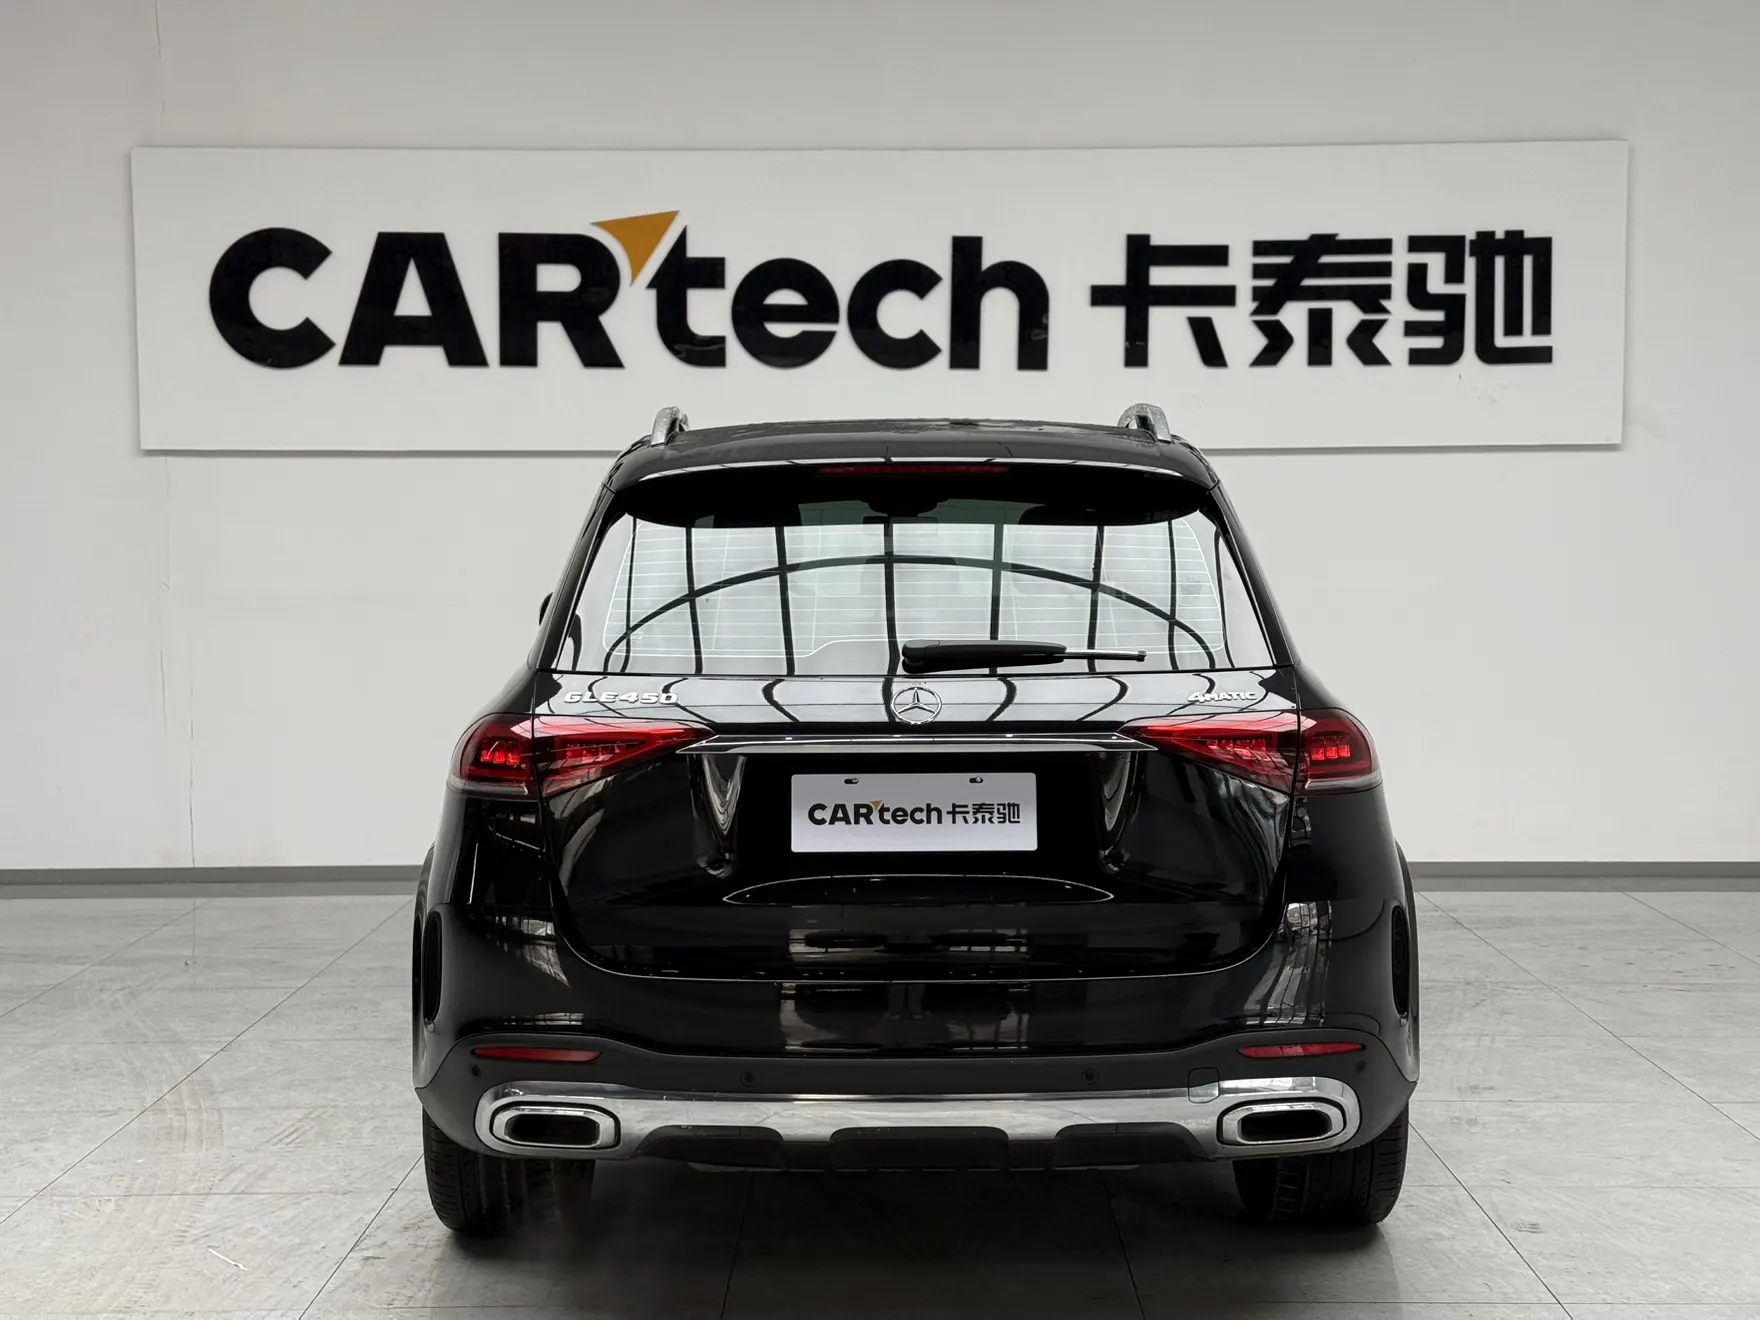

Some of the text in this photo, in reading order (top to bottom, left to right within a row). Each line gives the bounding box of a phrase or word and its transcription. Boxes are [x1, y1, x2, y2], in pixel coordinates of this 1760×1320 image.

[209, 211, 1554, 371] CARtech 卡泰驰
[1187, 690, 1258, 703] 4MATIC
[807, 800, 1021, 826] CARtech 卡泰驰
